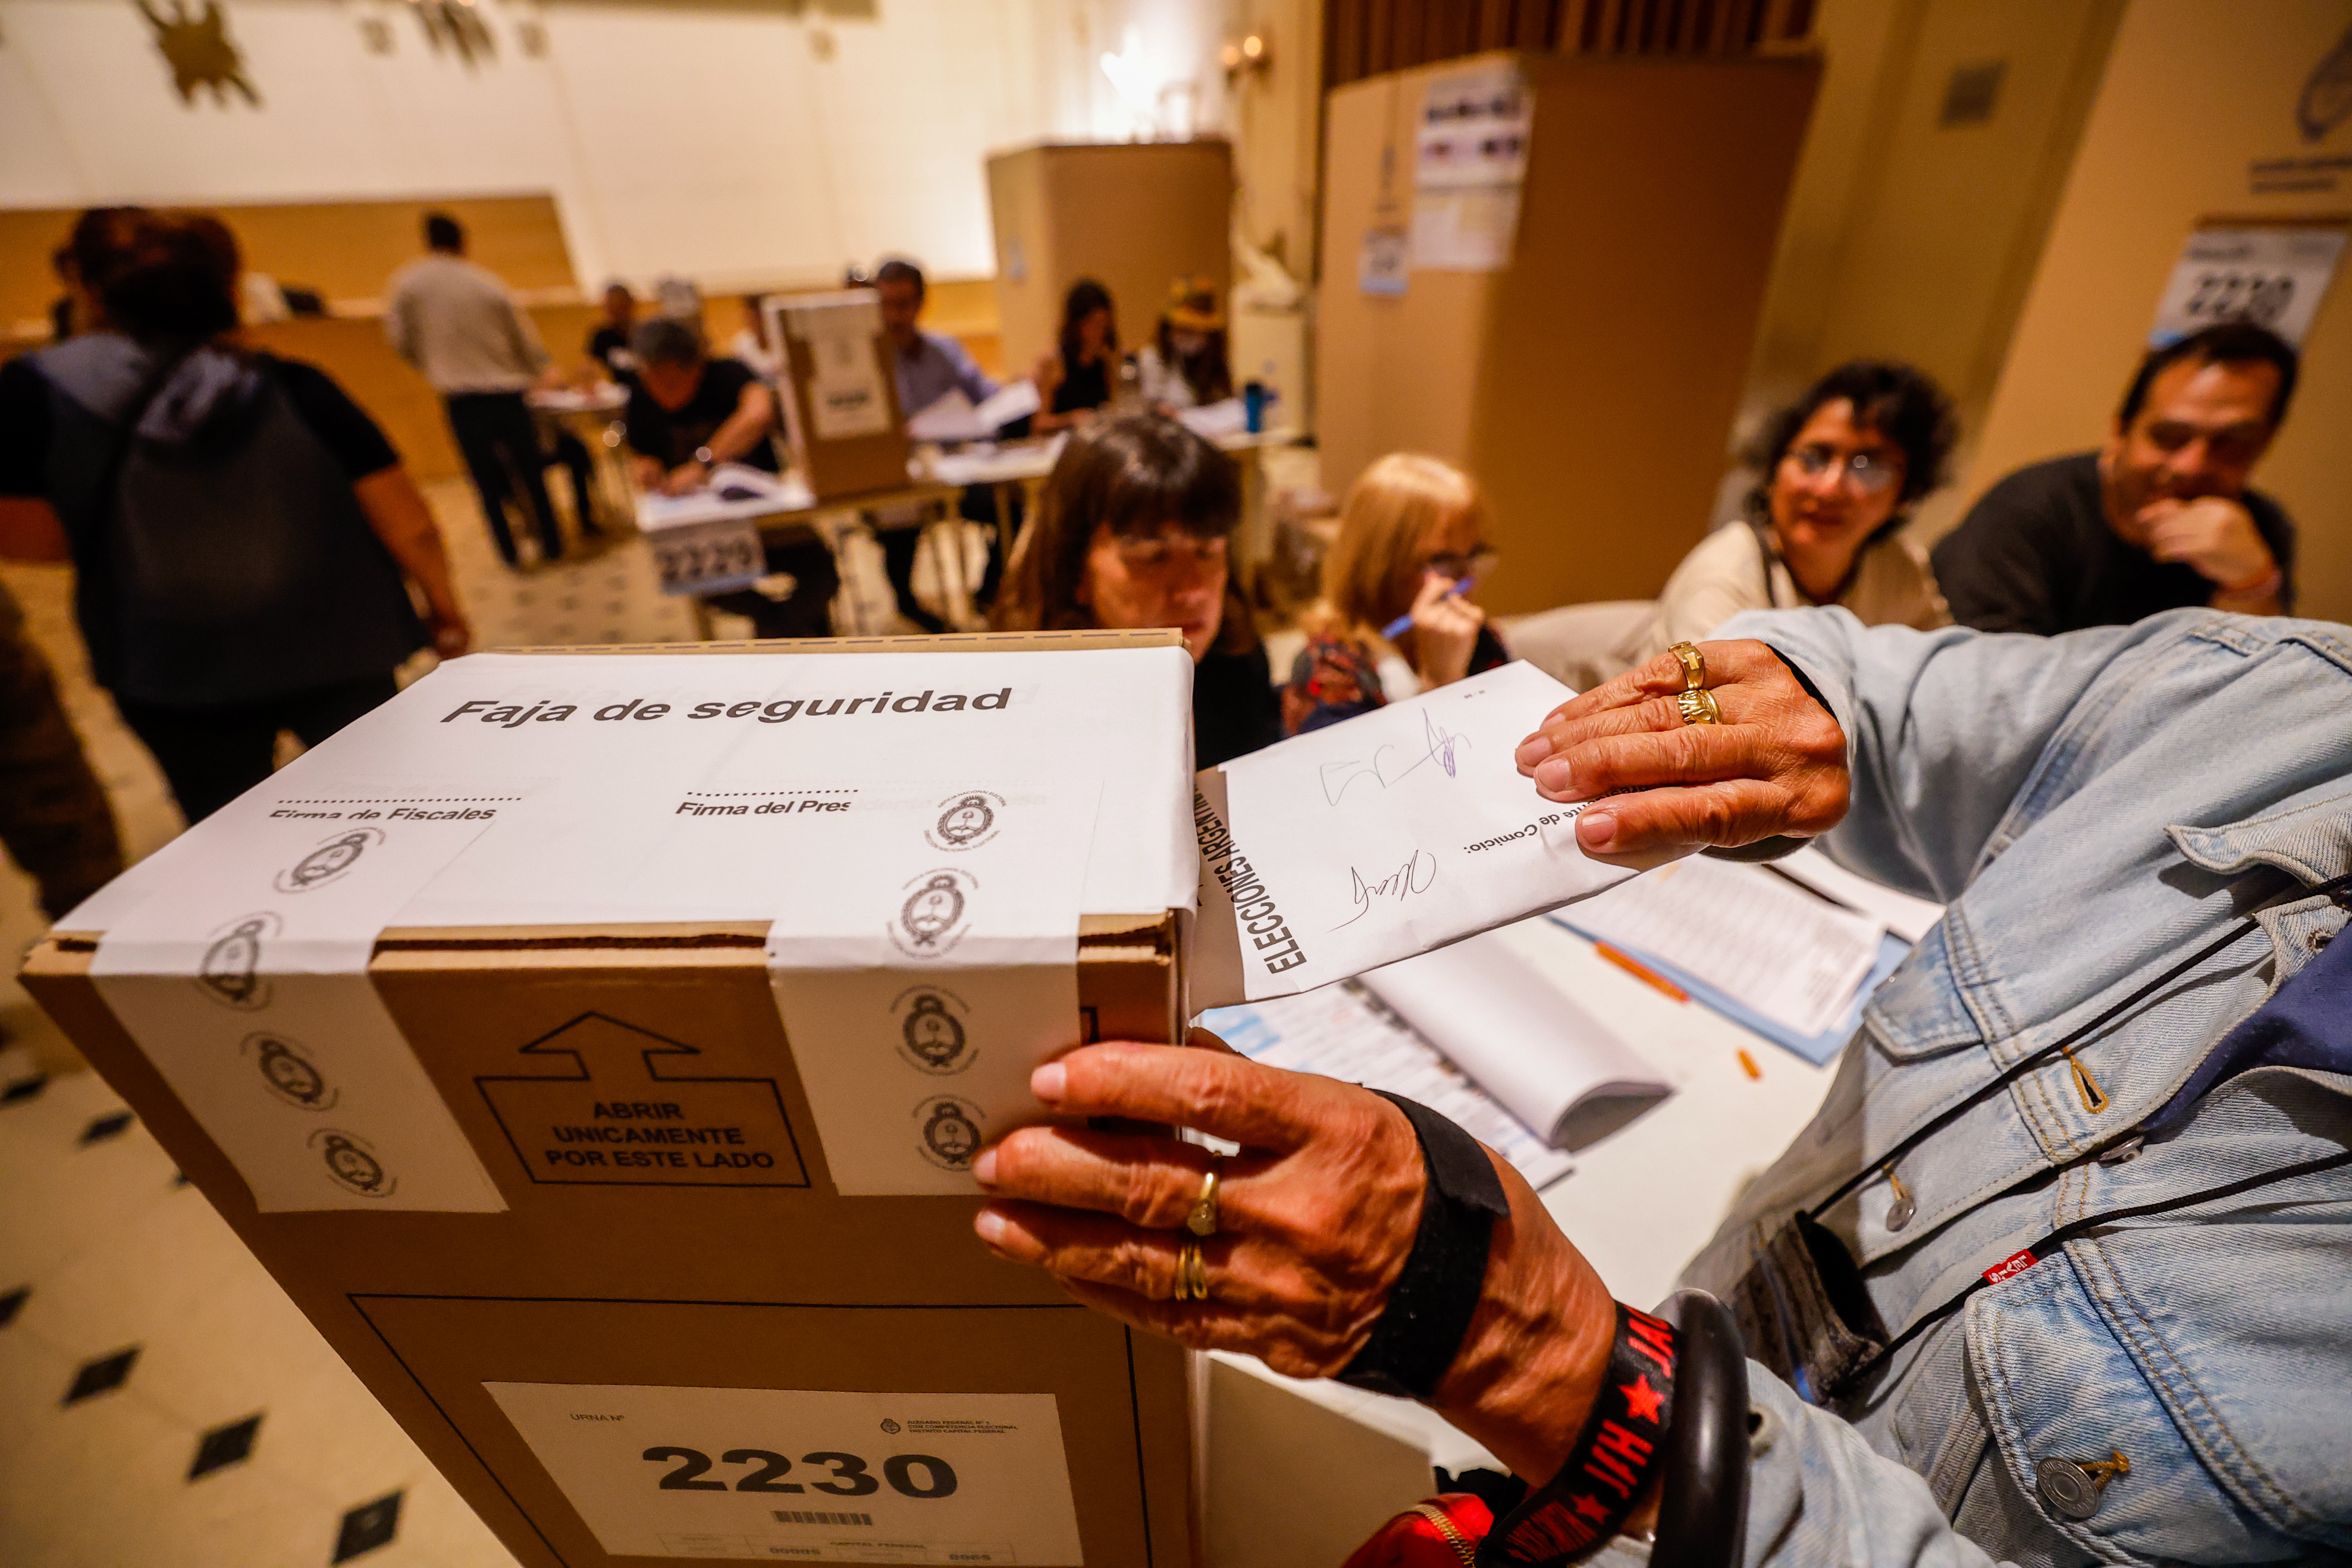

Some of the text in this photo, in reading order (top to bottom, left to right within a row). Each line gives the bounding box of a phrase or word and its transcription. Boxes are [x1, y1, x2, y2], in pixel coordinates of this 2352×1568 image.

[440, 687, 1013, 729] Faja de seguridad
[347, 809, 381, 820] de
[387, 808, 497, 820] Fiscales
[675, 802, 748, 816] Firma
[754, 800, 795, 815] del
[1538, 814, 1561, 826] de
[1463, 824, 1538, 854] Comicio:
[1214, 856, 1307, 975] ELECCIONES
[593, 1102, 684, 1120] ABRIR
[552, 1127, 745, 1145] UNICAMENTE
[545, 1149, 775, 1169] POR ESTE LADO
[642, 1446, 958, 1499] 2230
